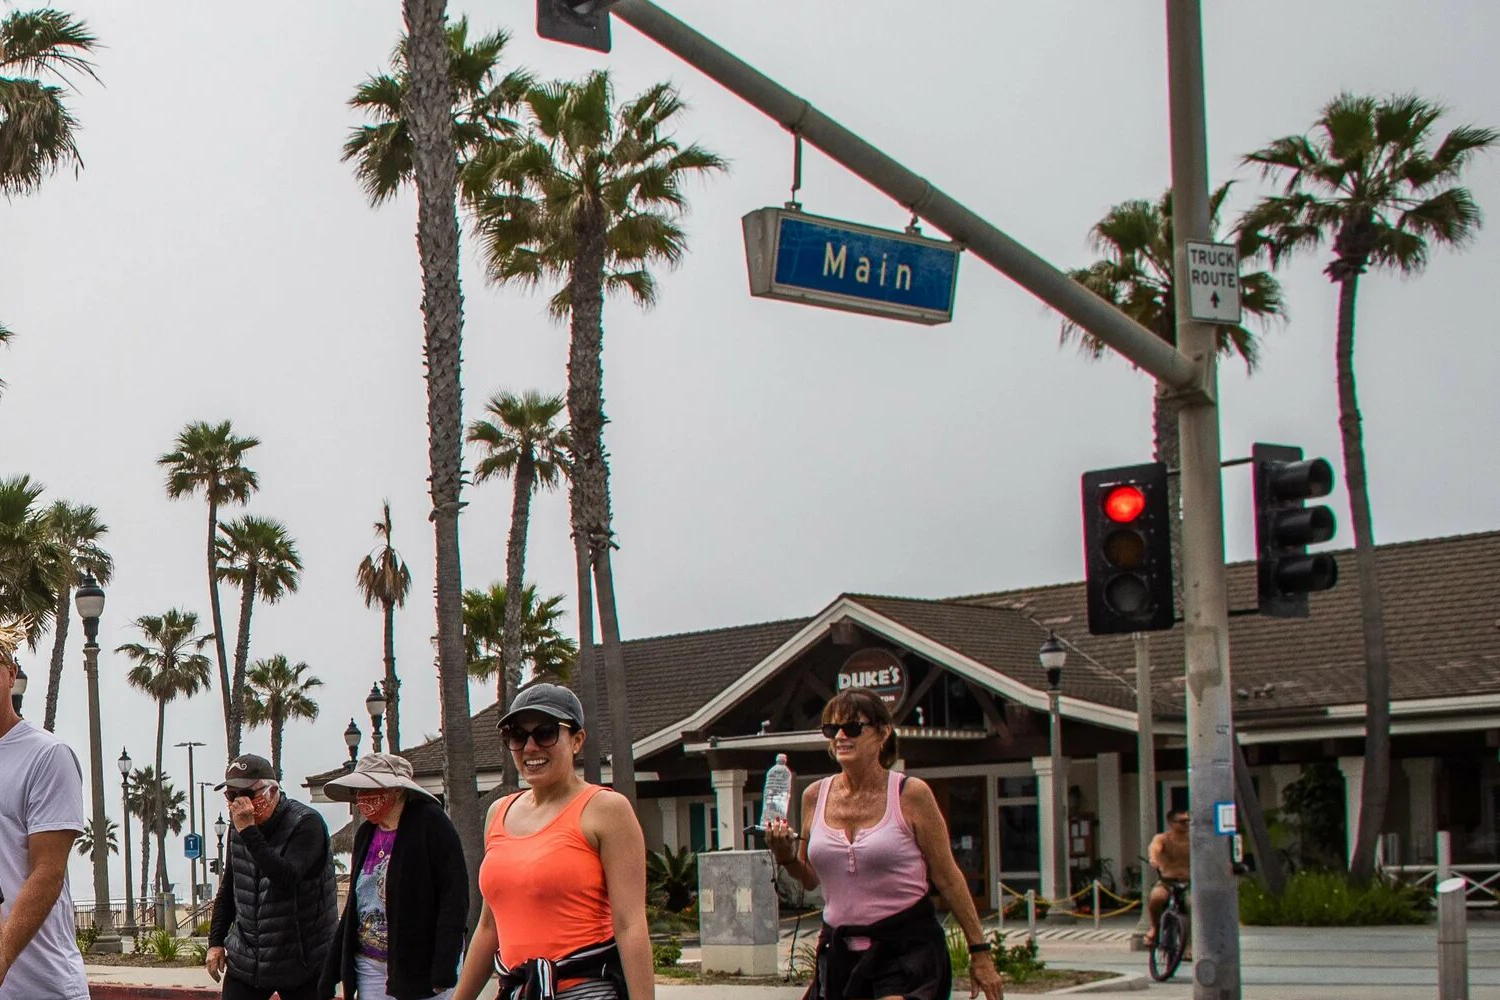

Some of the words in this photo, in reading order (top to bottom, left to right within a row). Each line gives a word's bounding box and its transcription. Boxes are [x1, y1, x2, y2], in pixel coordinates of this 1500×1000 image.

[822, 241, 912, 291] Main
[1190, 249, 1235, 268] TRUCK
[1192, 269, 1236, 288] ROUTE
[838, 665, 900, 690] DUKE'S
